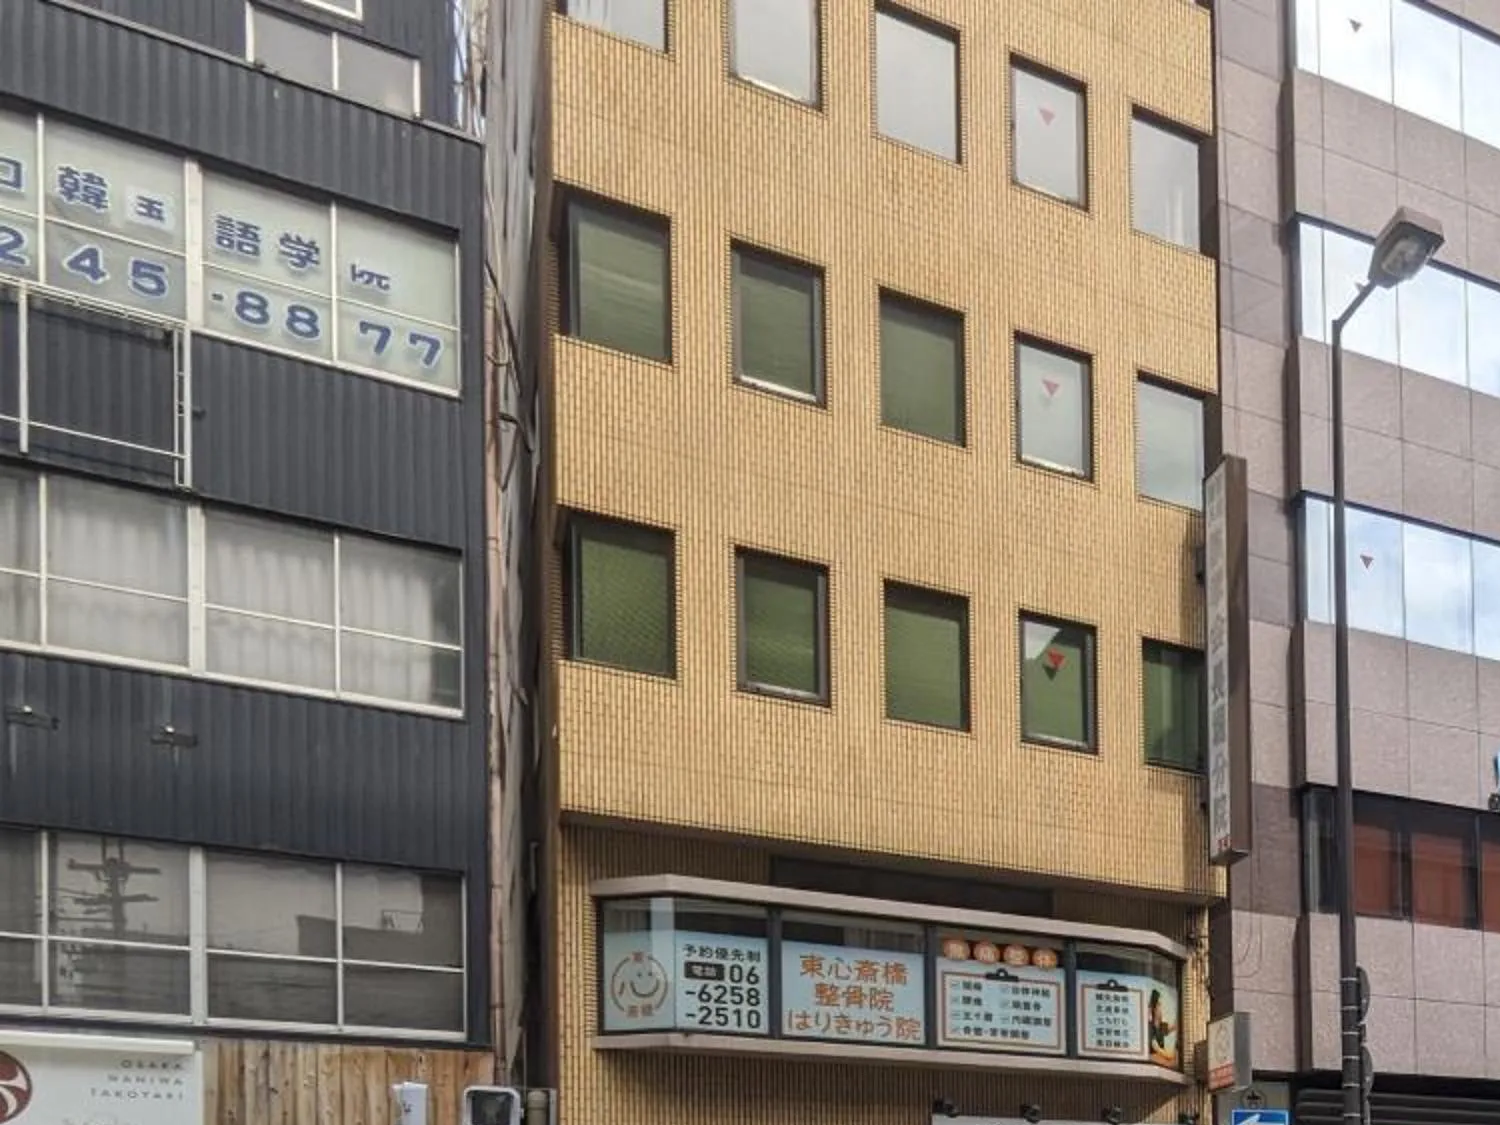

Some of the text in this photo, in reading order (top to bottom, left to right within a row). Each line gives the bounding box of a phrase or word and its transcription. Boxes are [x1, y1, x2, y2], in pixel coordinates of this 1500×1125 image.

[683, 943, 762, 962] 予約優先制
[729, 964, 761, 985] 06
[799, 952, 910, 986] 東心斎橋
[685, 983, 762, 1007] -6258
[815, 982, 895, 1012] 整骨院
[685, 1006, 762, 1029] -2510
[787, 1008, 922, 1041] はりきゅう院
[120, 1058, 184, 1070] OSAKA
[107, 1074, 184, 1086] NANIWA
[90, 1087, 184, 1100] TAKOYAKI
